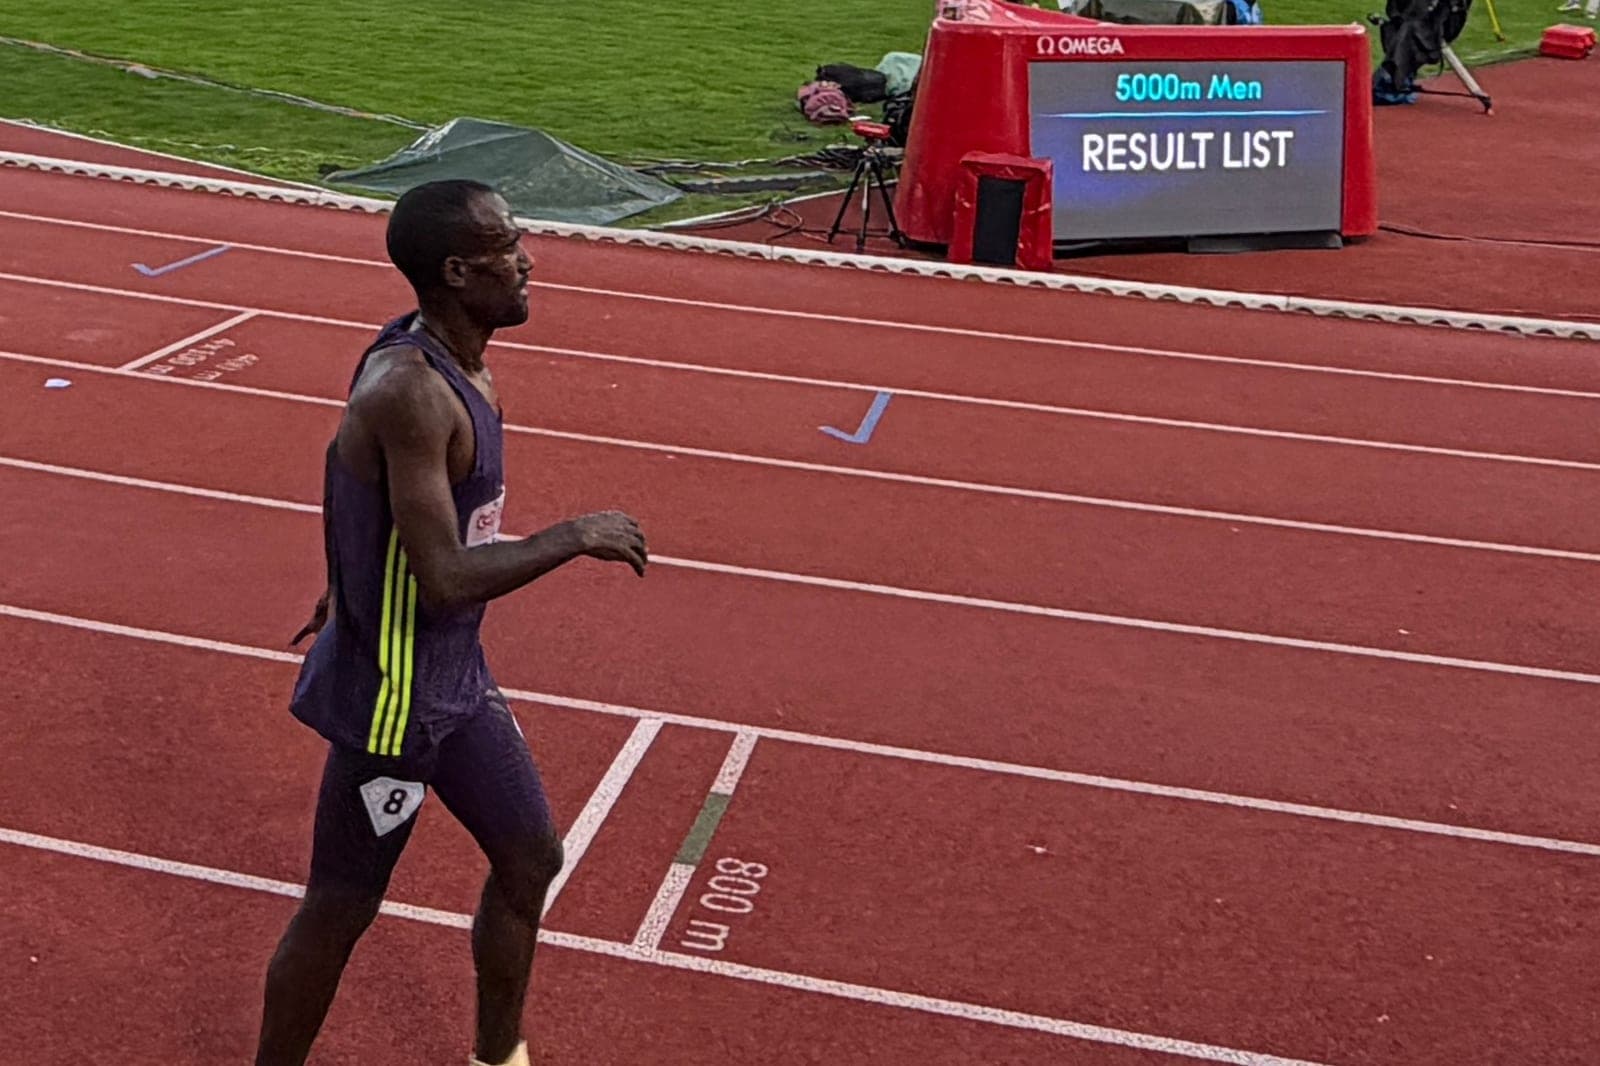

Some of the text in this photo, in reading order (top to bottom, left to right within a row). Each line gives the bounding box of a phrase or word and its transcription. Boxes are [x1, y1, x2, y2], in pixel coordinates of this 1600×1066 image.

[1058, 36, 1124, 55] OMEGA
[1115, 73, 1262, 101] 5000m Men
[1082, 130, 1294, 172] RESULT LIST
[383, 788, 408, 815] 8
[699, 857, 769, 914] 800
